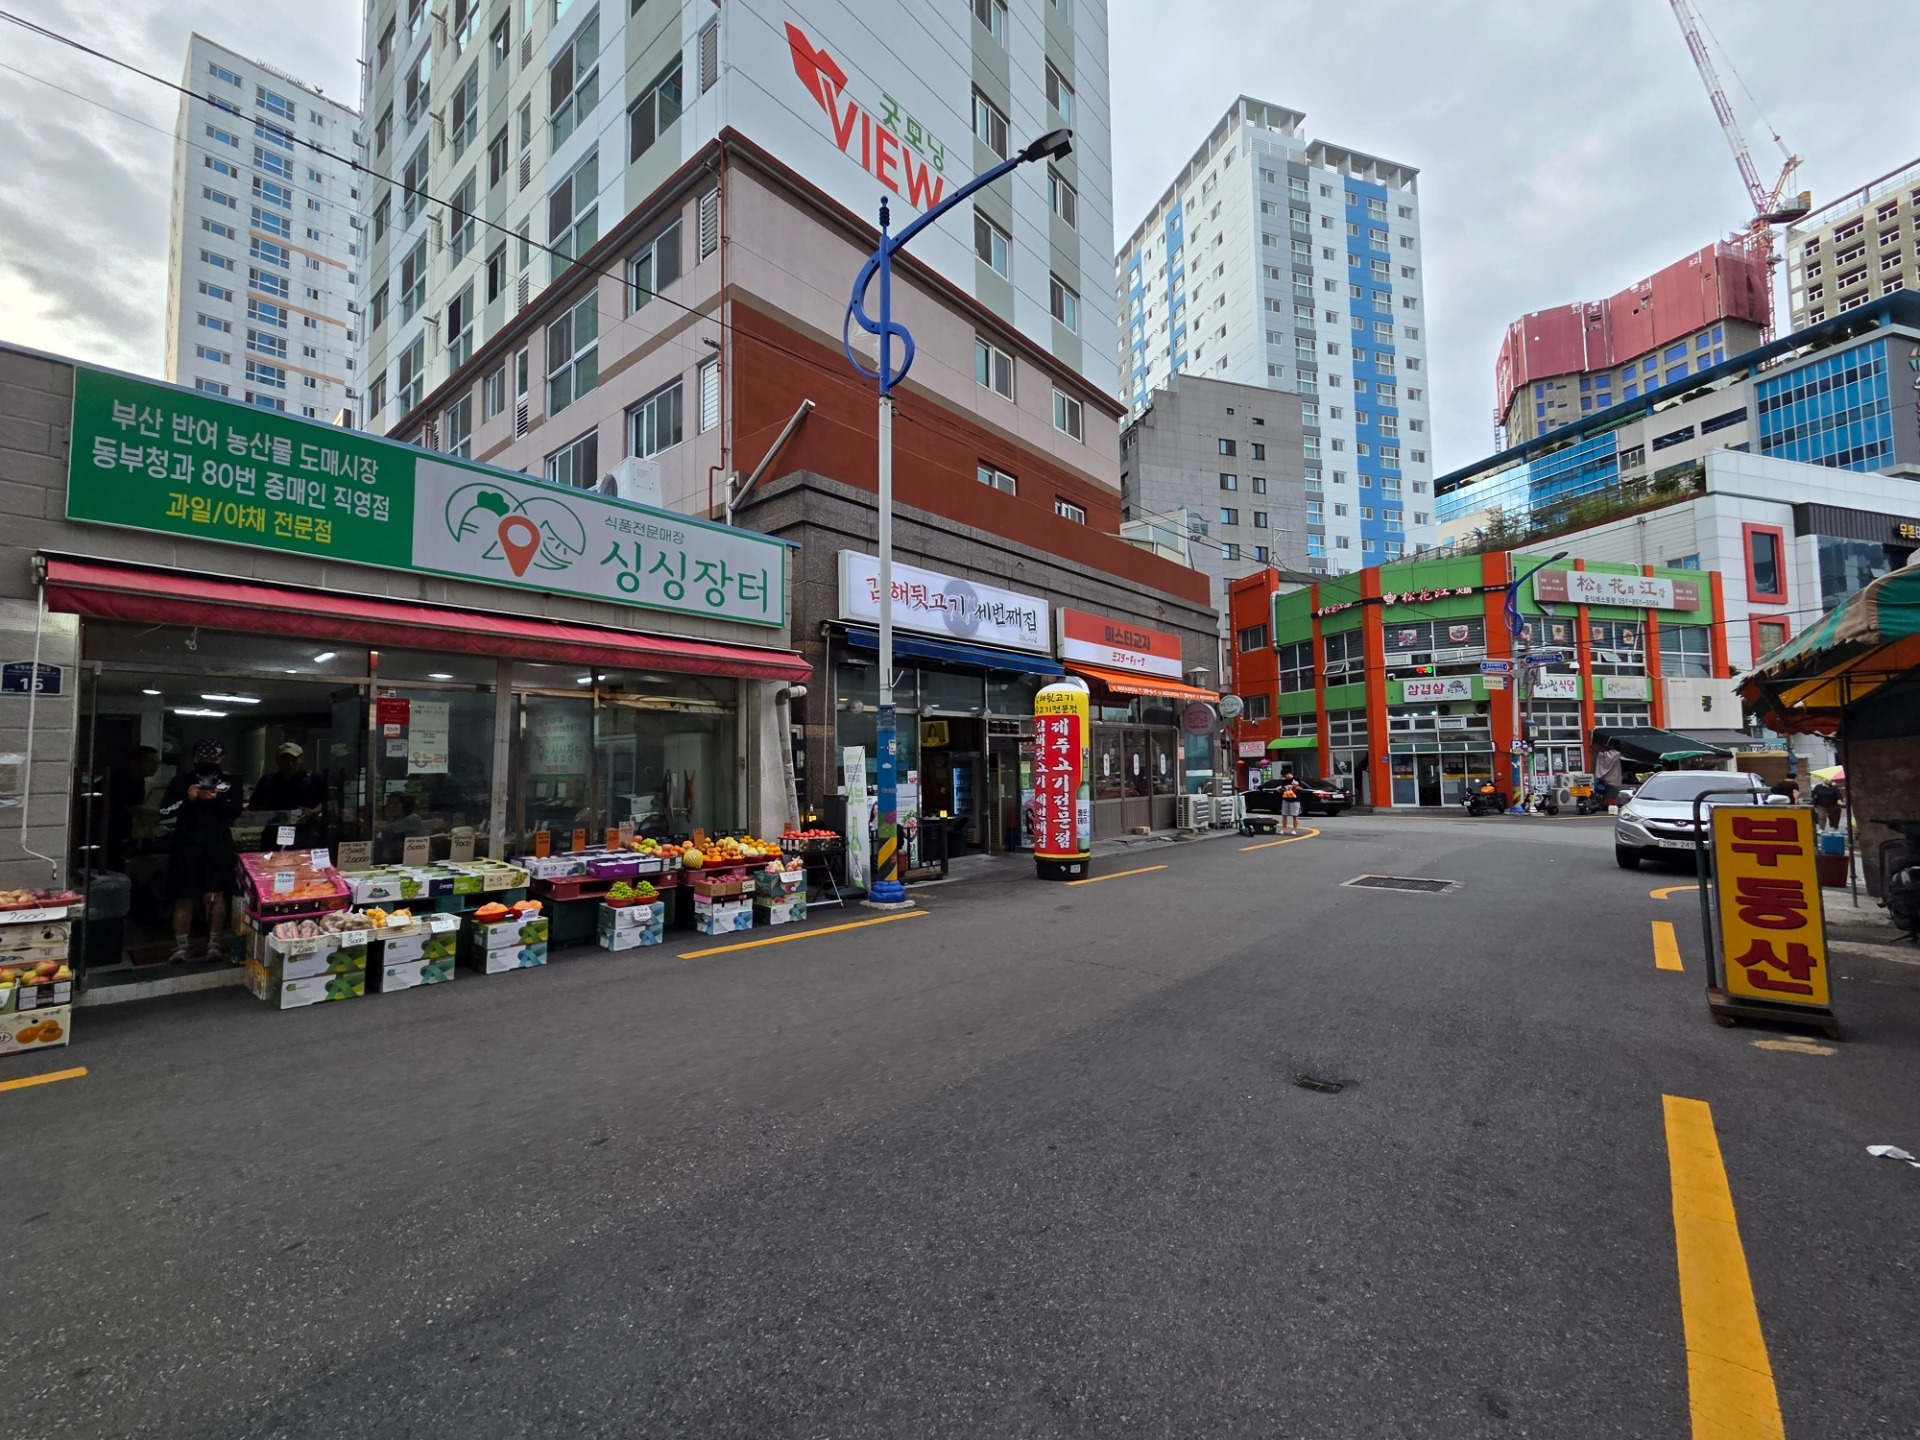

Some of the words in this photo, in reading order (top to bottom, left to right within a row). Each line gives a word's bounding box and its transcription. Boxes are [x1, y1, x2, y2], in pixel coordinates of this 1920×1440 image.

[822, 76, 944, 212] VIEW
[879, 92, 945, 173] 굿모닝
[1688, 256, 1699, 268] 32
[1640, 282, 1650, 293] 33
[1587, 306, 1598, 314] 34
[111, 398, 164, 439] 부산
[171, 411, 218, 451] 반여
[226, 425, 293, 467] 농산물
[299, 442, 380, 486] 도매시장
[91, 435, 196, 484] 동부청과
[201, 458, 256, 498] 80번
[263, 471, 327, 510] 중매인
[332, 484, 391, 523] 직영점
[165, 491, 266, 533] 과일/야채
[272, 510, 333, 545] 전문점
[603, 514, 685, 546] 식품전문매장
[599, 540, 769, 615] 싱싱장터
[973, 602, 1038, 633] 세번째집
[1104, 625, 1151, 651] 미스타교자
[1559, 679, 1575, 692] 식당
[1051, 717, 1074, 850] 제주고기전문점
[9, 911, 47, 921] 2000
[1730, 816, 1818, 996] 부동산
